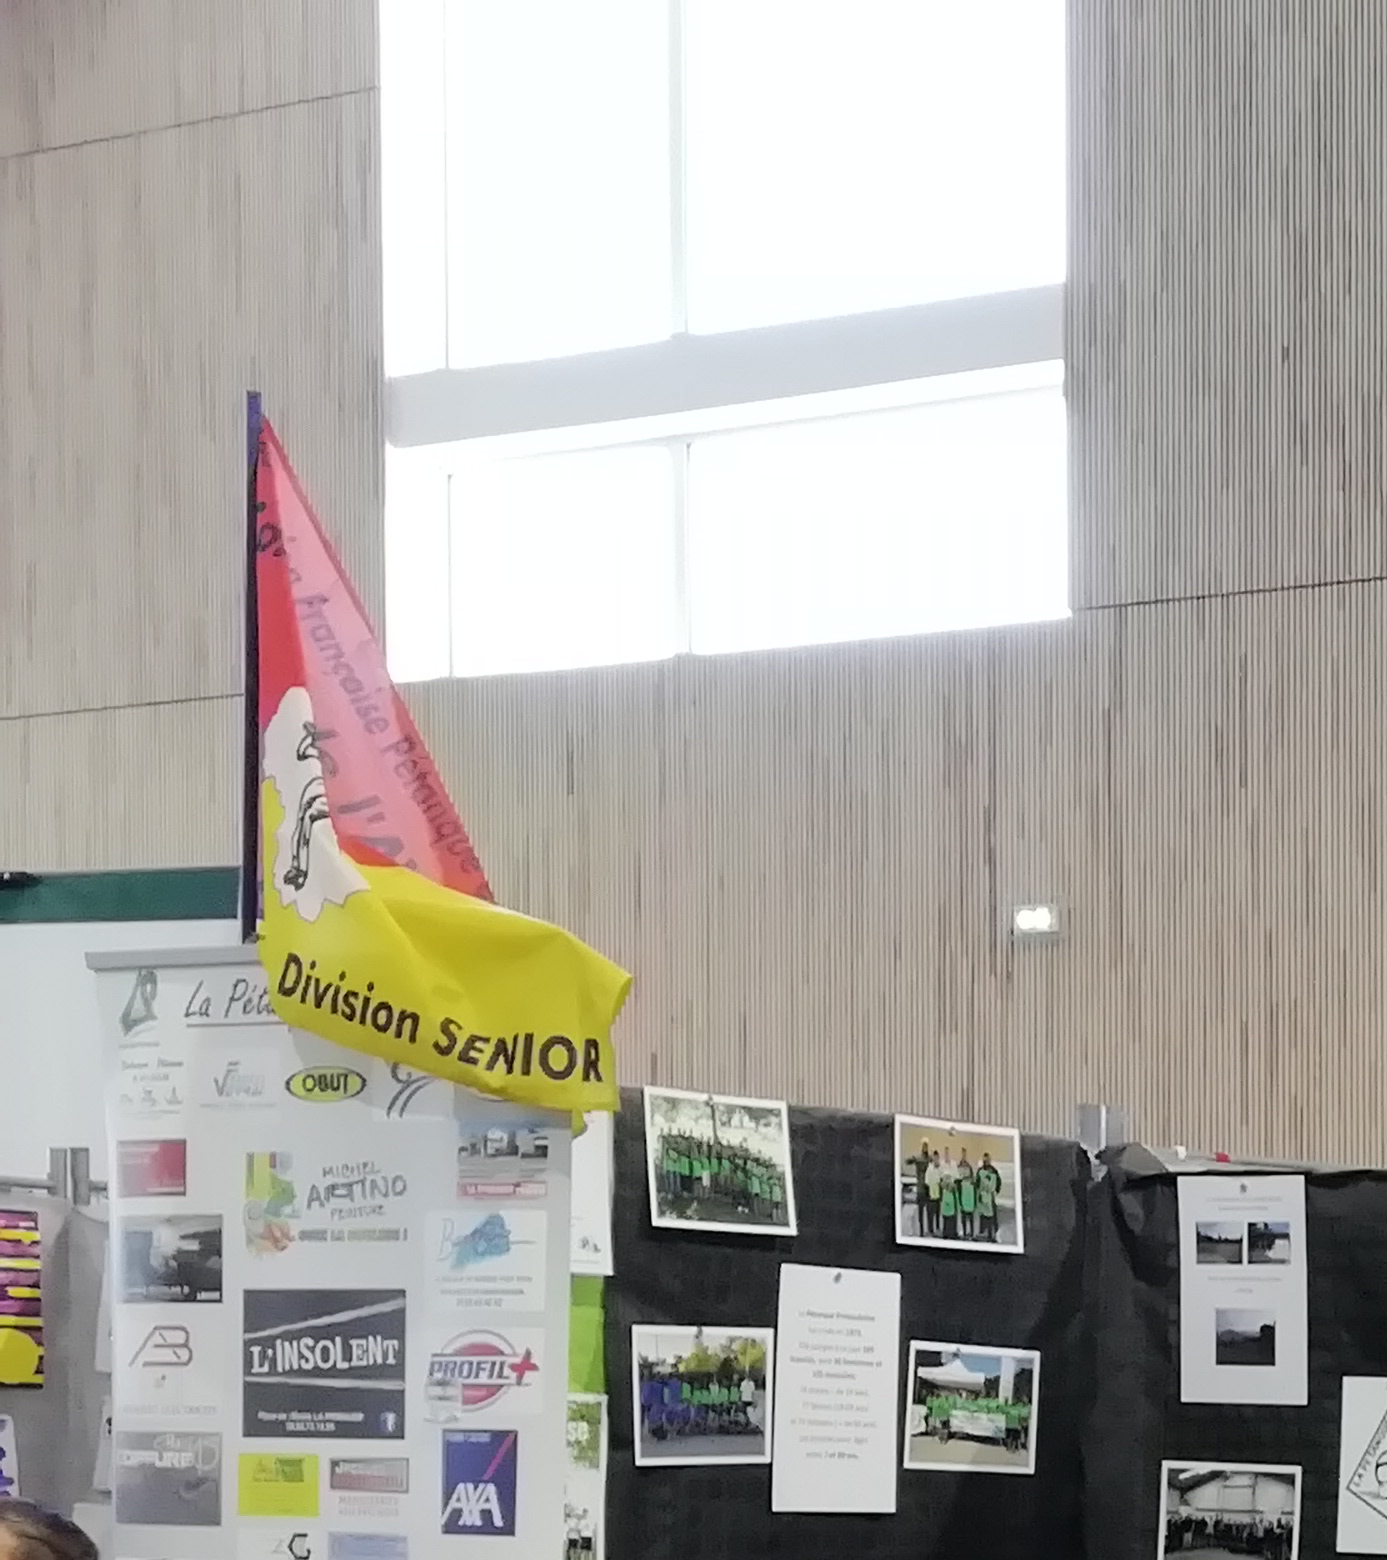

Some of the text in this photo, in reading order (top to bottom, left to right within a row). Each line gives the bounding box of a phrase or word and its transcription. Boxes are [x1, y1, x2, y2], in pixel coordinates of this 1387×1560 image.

[277, 952, 603, 1083] Division SENIOR
[302, 1074, 349, 1095] OBUT
[249, 1335, 399, 1373] L'INSOLENT
[442, 1481, 504, 1527] AXA
